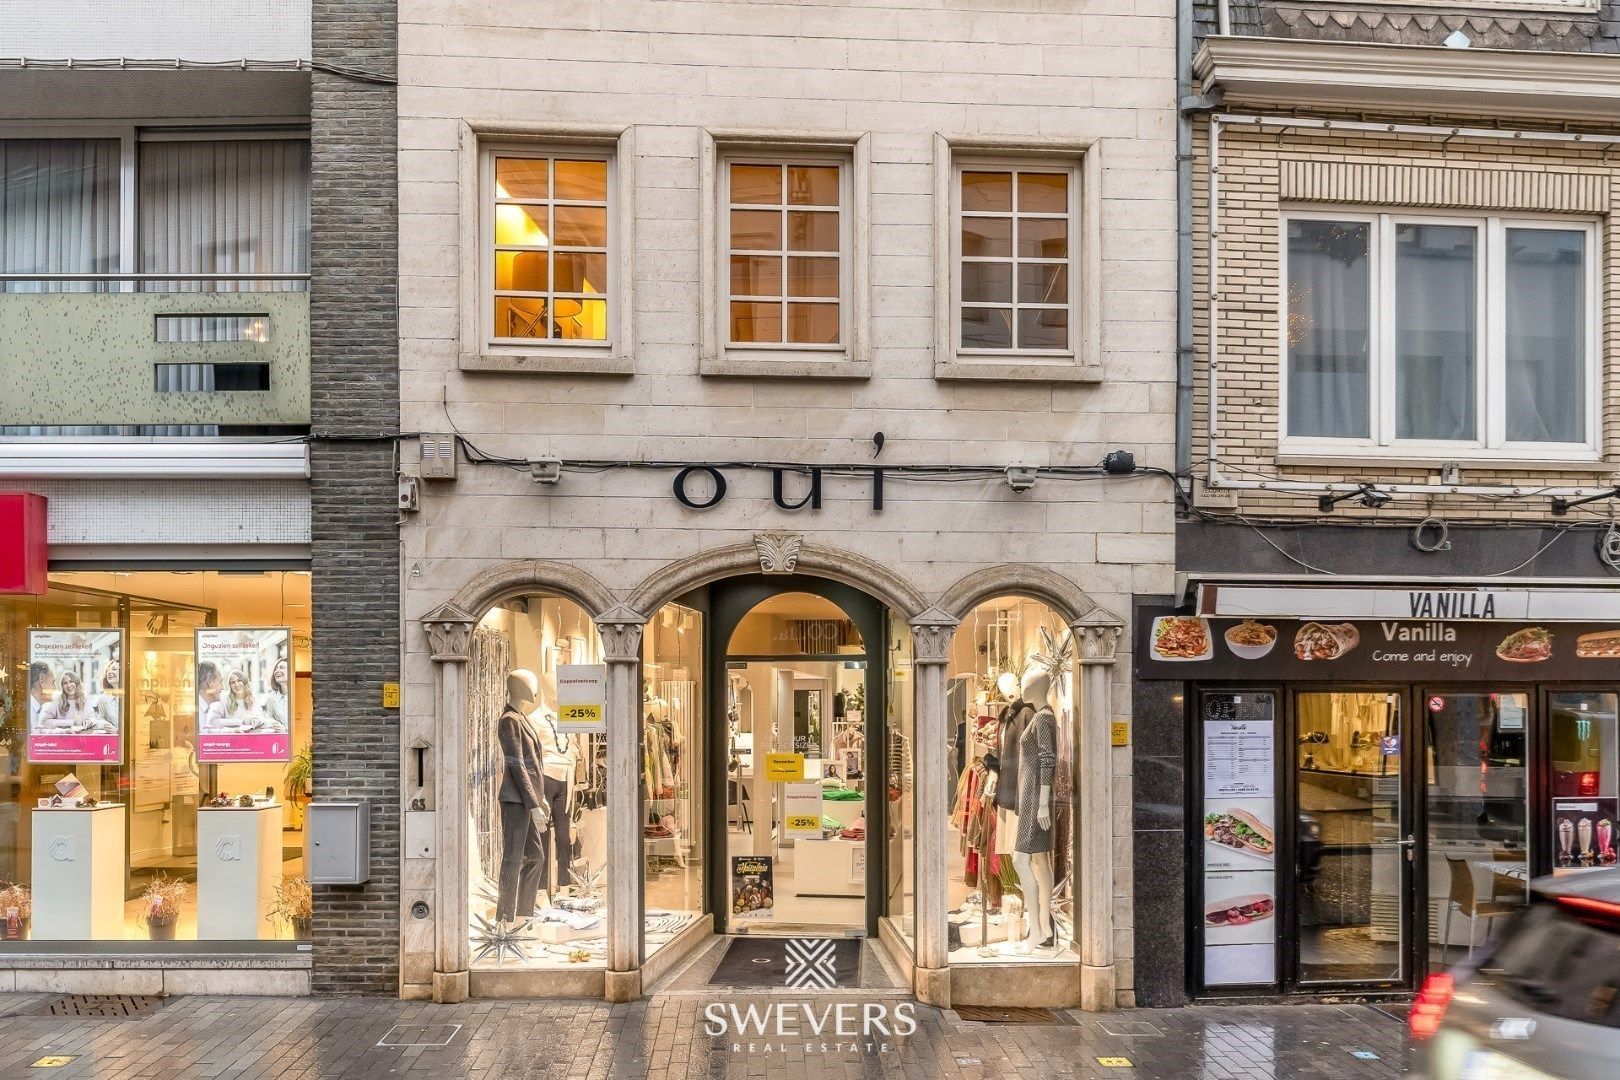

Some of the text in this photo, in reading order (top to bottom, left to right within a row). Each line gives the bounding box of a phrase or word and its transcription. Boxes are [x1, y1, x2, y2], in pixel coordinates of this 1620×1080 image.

[1409, 592, 1495, 619] VANILLA
[1381, 621, 1456, 641] Vanilla
[34, 642, 64, 651] Ongezien
[201, 642, 231, 651] Ongezien
[1372, 648, 1472, 667] Come and enjoy
[565, 708, 596, 718] -25%
[411, 798, 426, 811] 63
[790, 819, 815, 827] -25%
